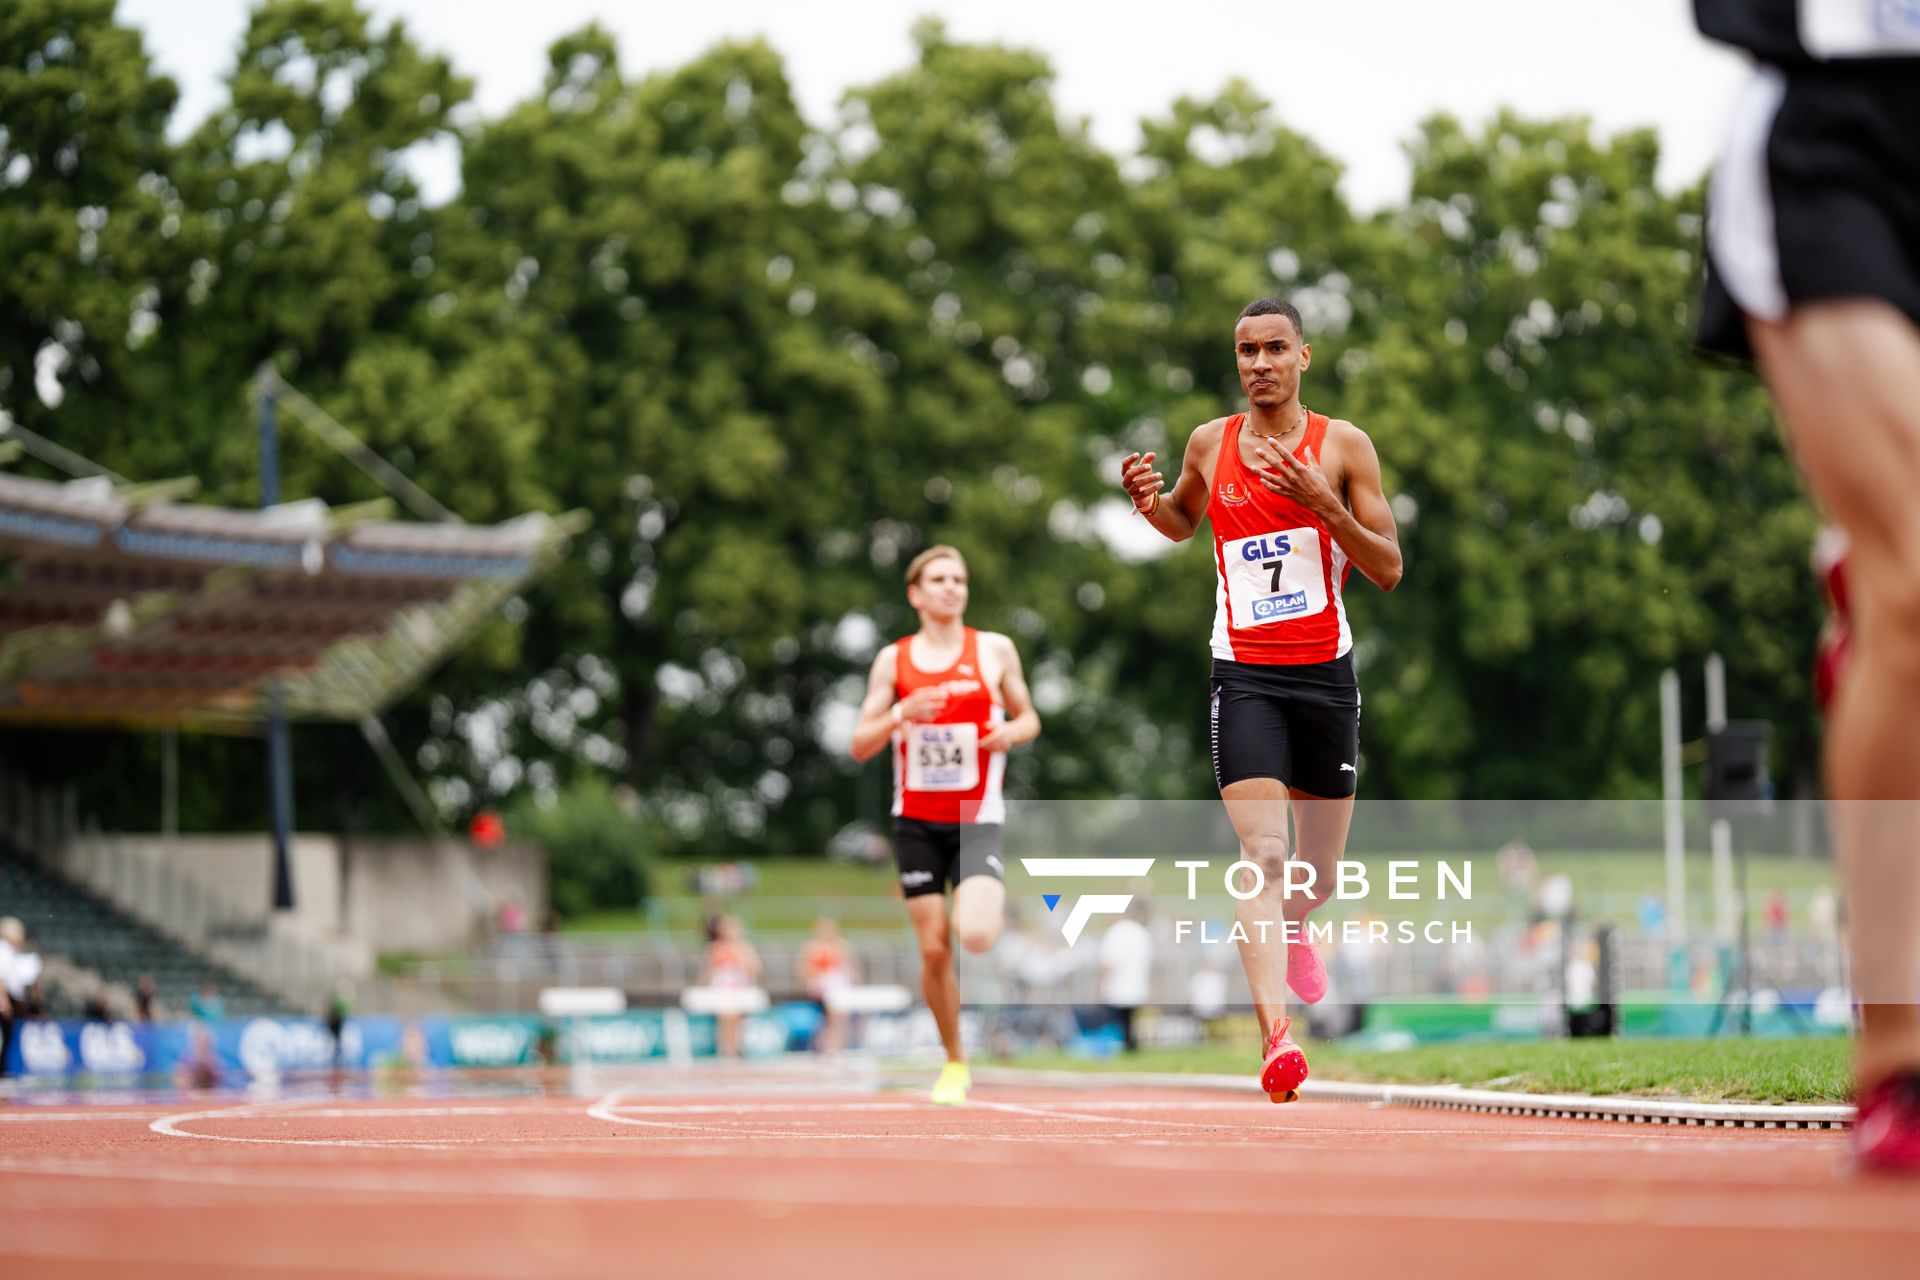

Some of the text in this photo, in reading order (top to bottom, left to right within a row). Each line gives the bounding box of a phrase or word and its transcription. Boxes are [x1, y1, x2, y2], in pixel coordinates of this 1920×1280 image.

[1262, 560, 1283, 593] 7
[1275, 594, 1305, 609] PLAN
[919, 745, 962, 768] 534
